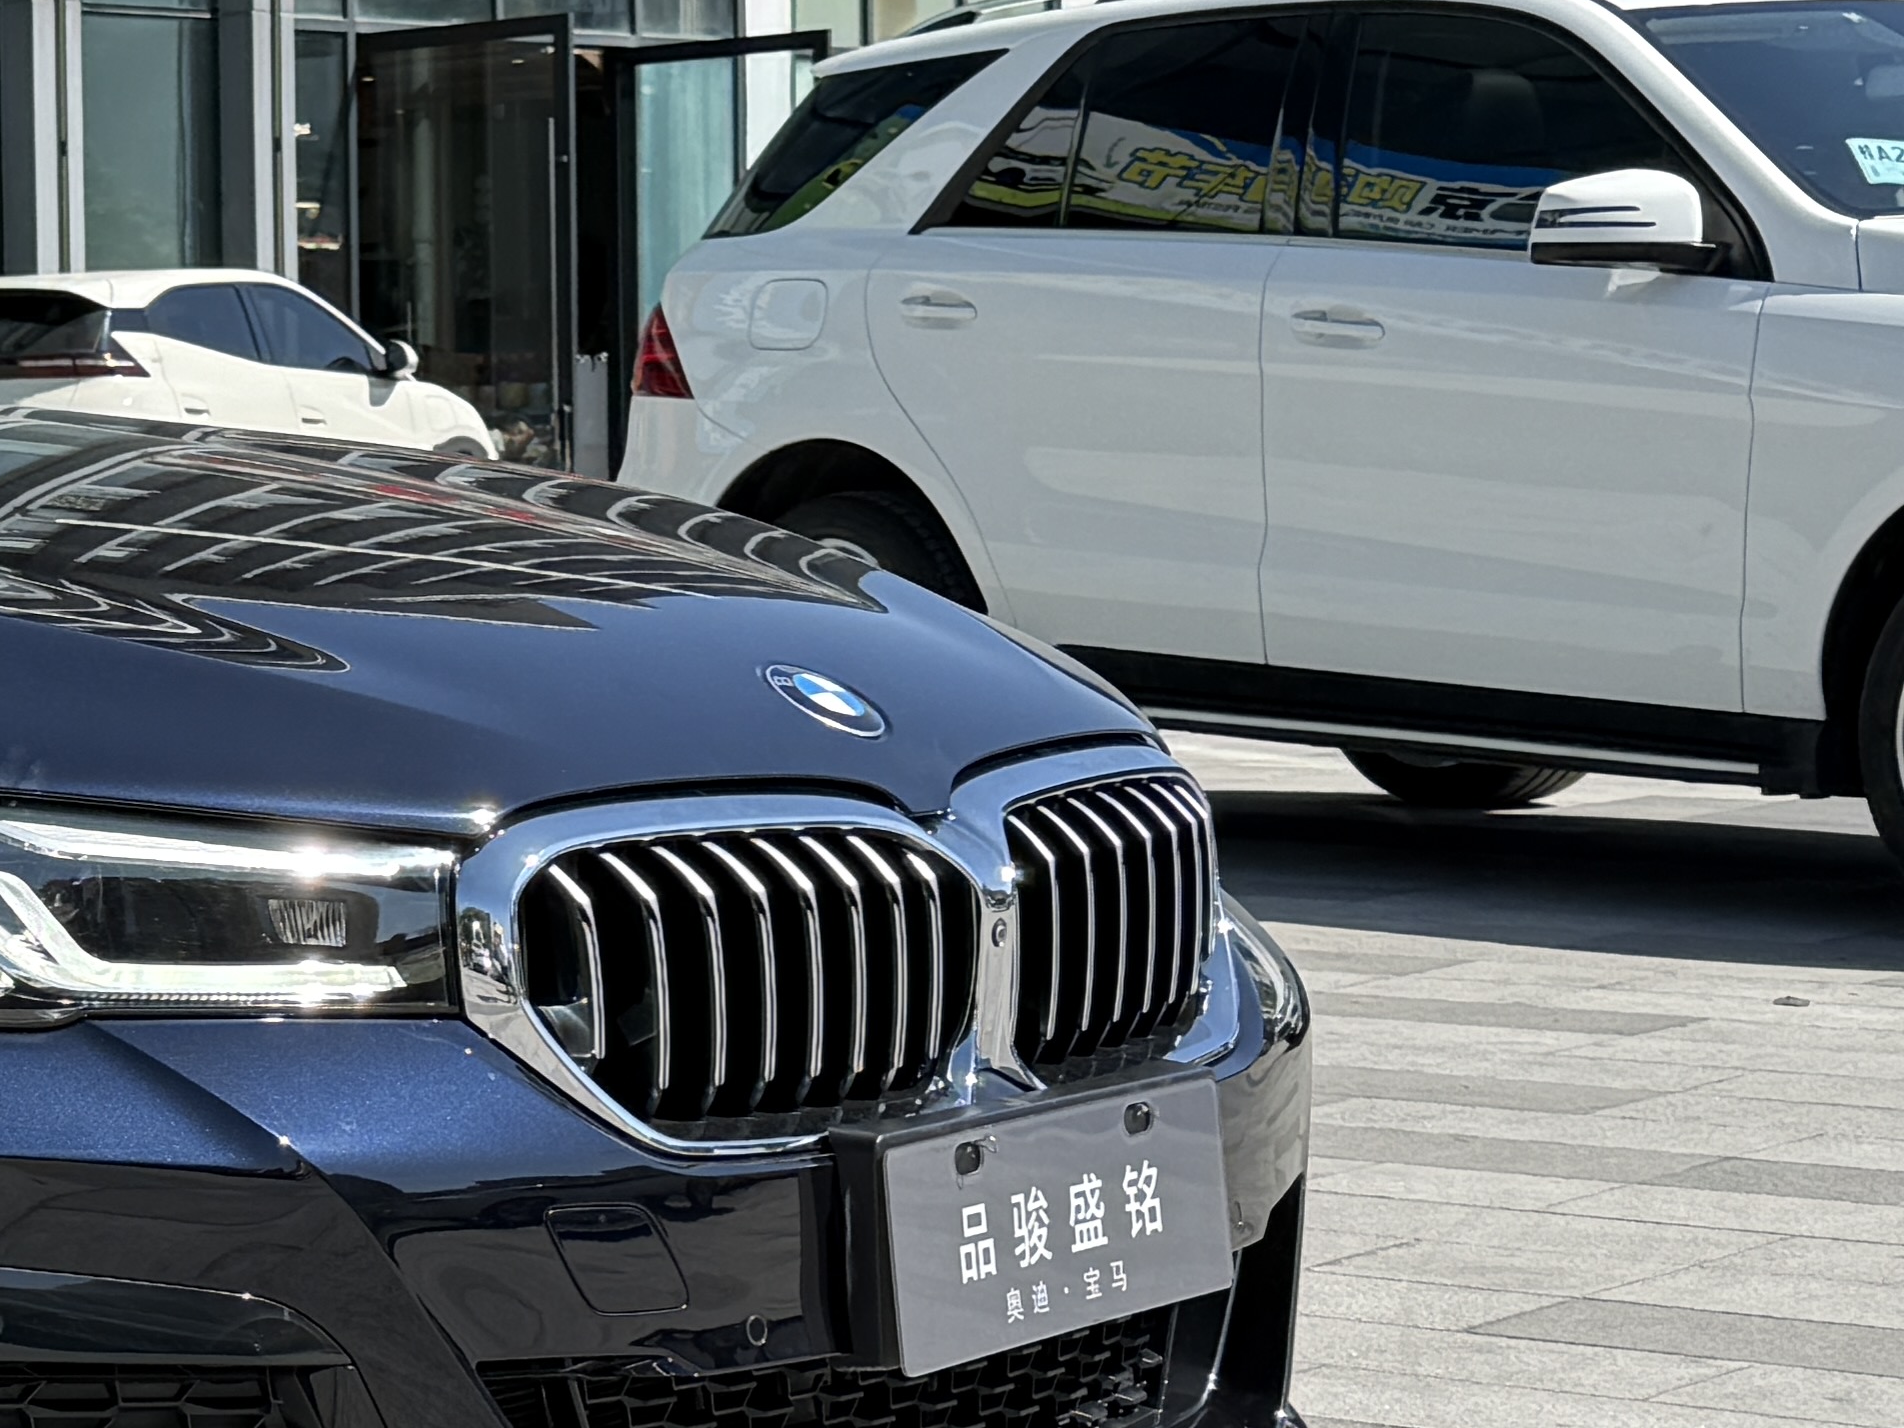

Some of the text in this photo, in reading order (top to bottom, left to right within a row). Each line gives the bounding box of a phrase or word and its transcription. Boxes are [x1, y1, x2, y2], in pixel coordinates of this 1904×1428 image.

[959, 1159, 1164, 1285] 品骏盛铭
[1005, 1259, 1128, 1324] 奥迪·宝马
